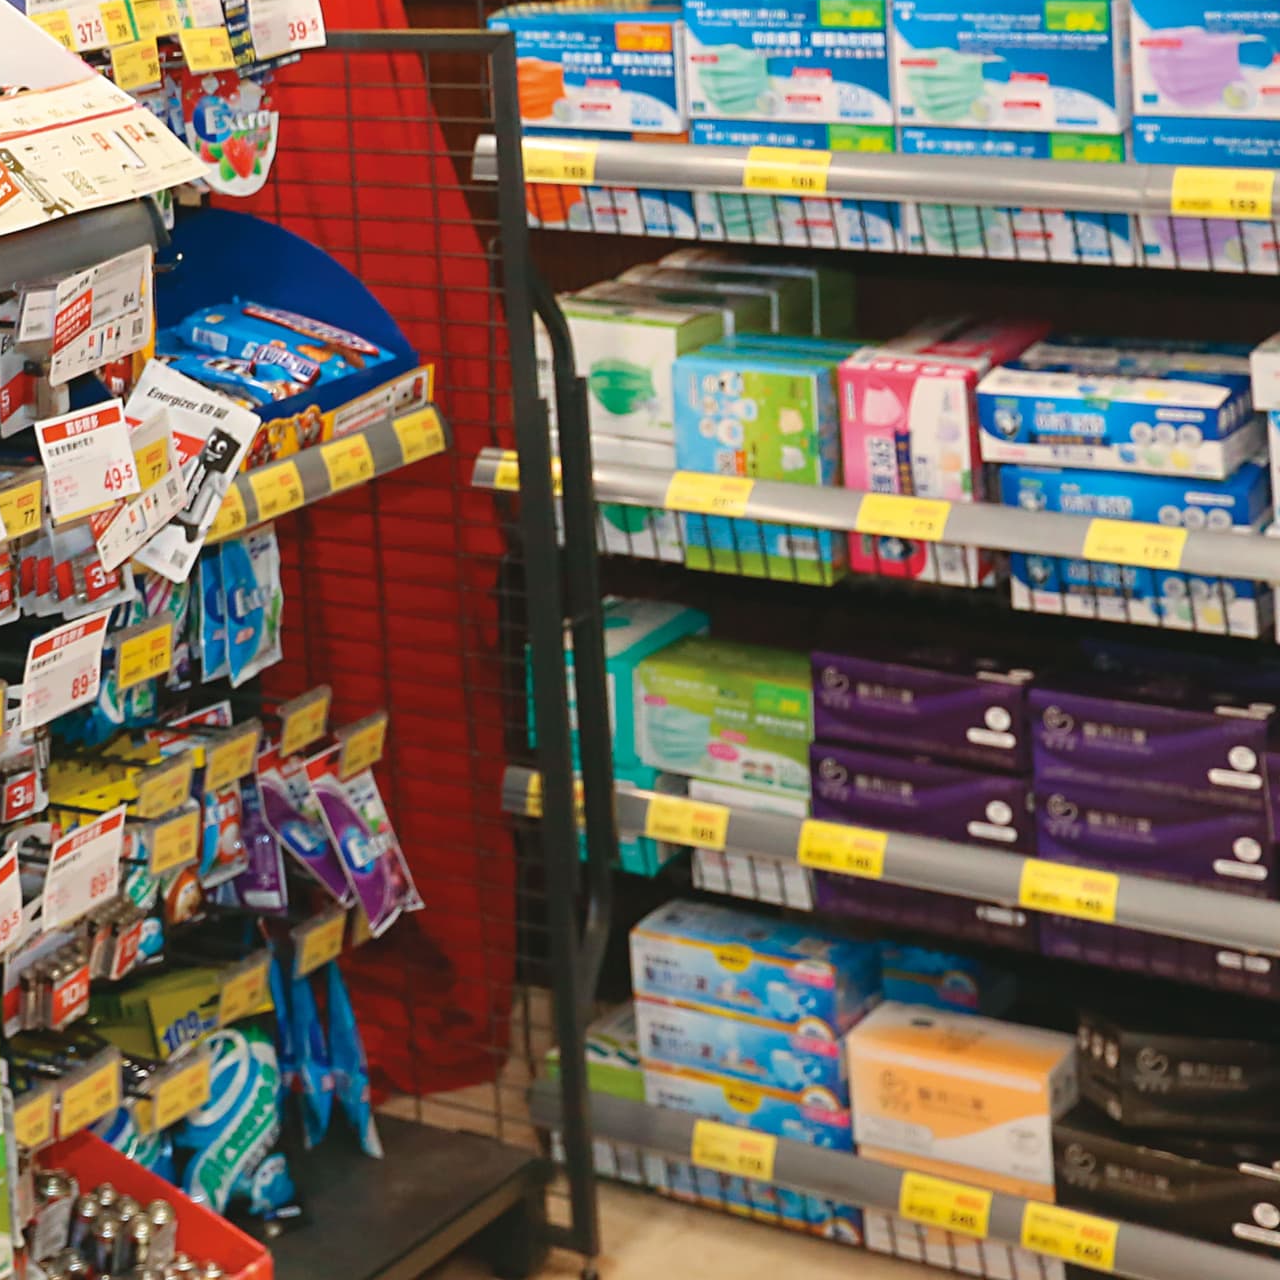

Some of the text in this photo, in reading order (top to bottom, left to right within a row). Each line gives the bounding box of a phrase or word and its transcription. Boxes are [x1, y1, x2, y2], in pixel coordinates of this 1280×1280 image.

[77, 19, 103, 45] 37.5
[146, 386, 200, 412] Energizer
[103, 463, 134, 492] 49.5
